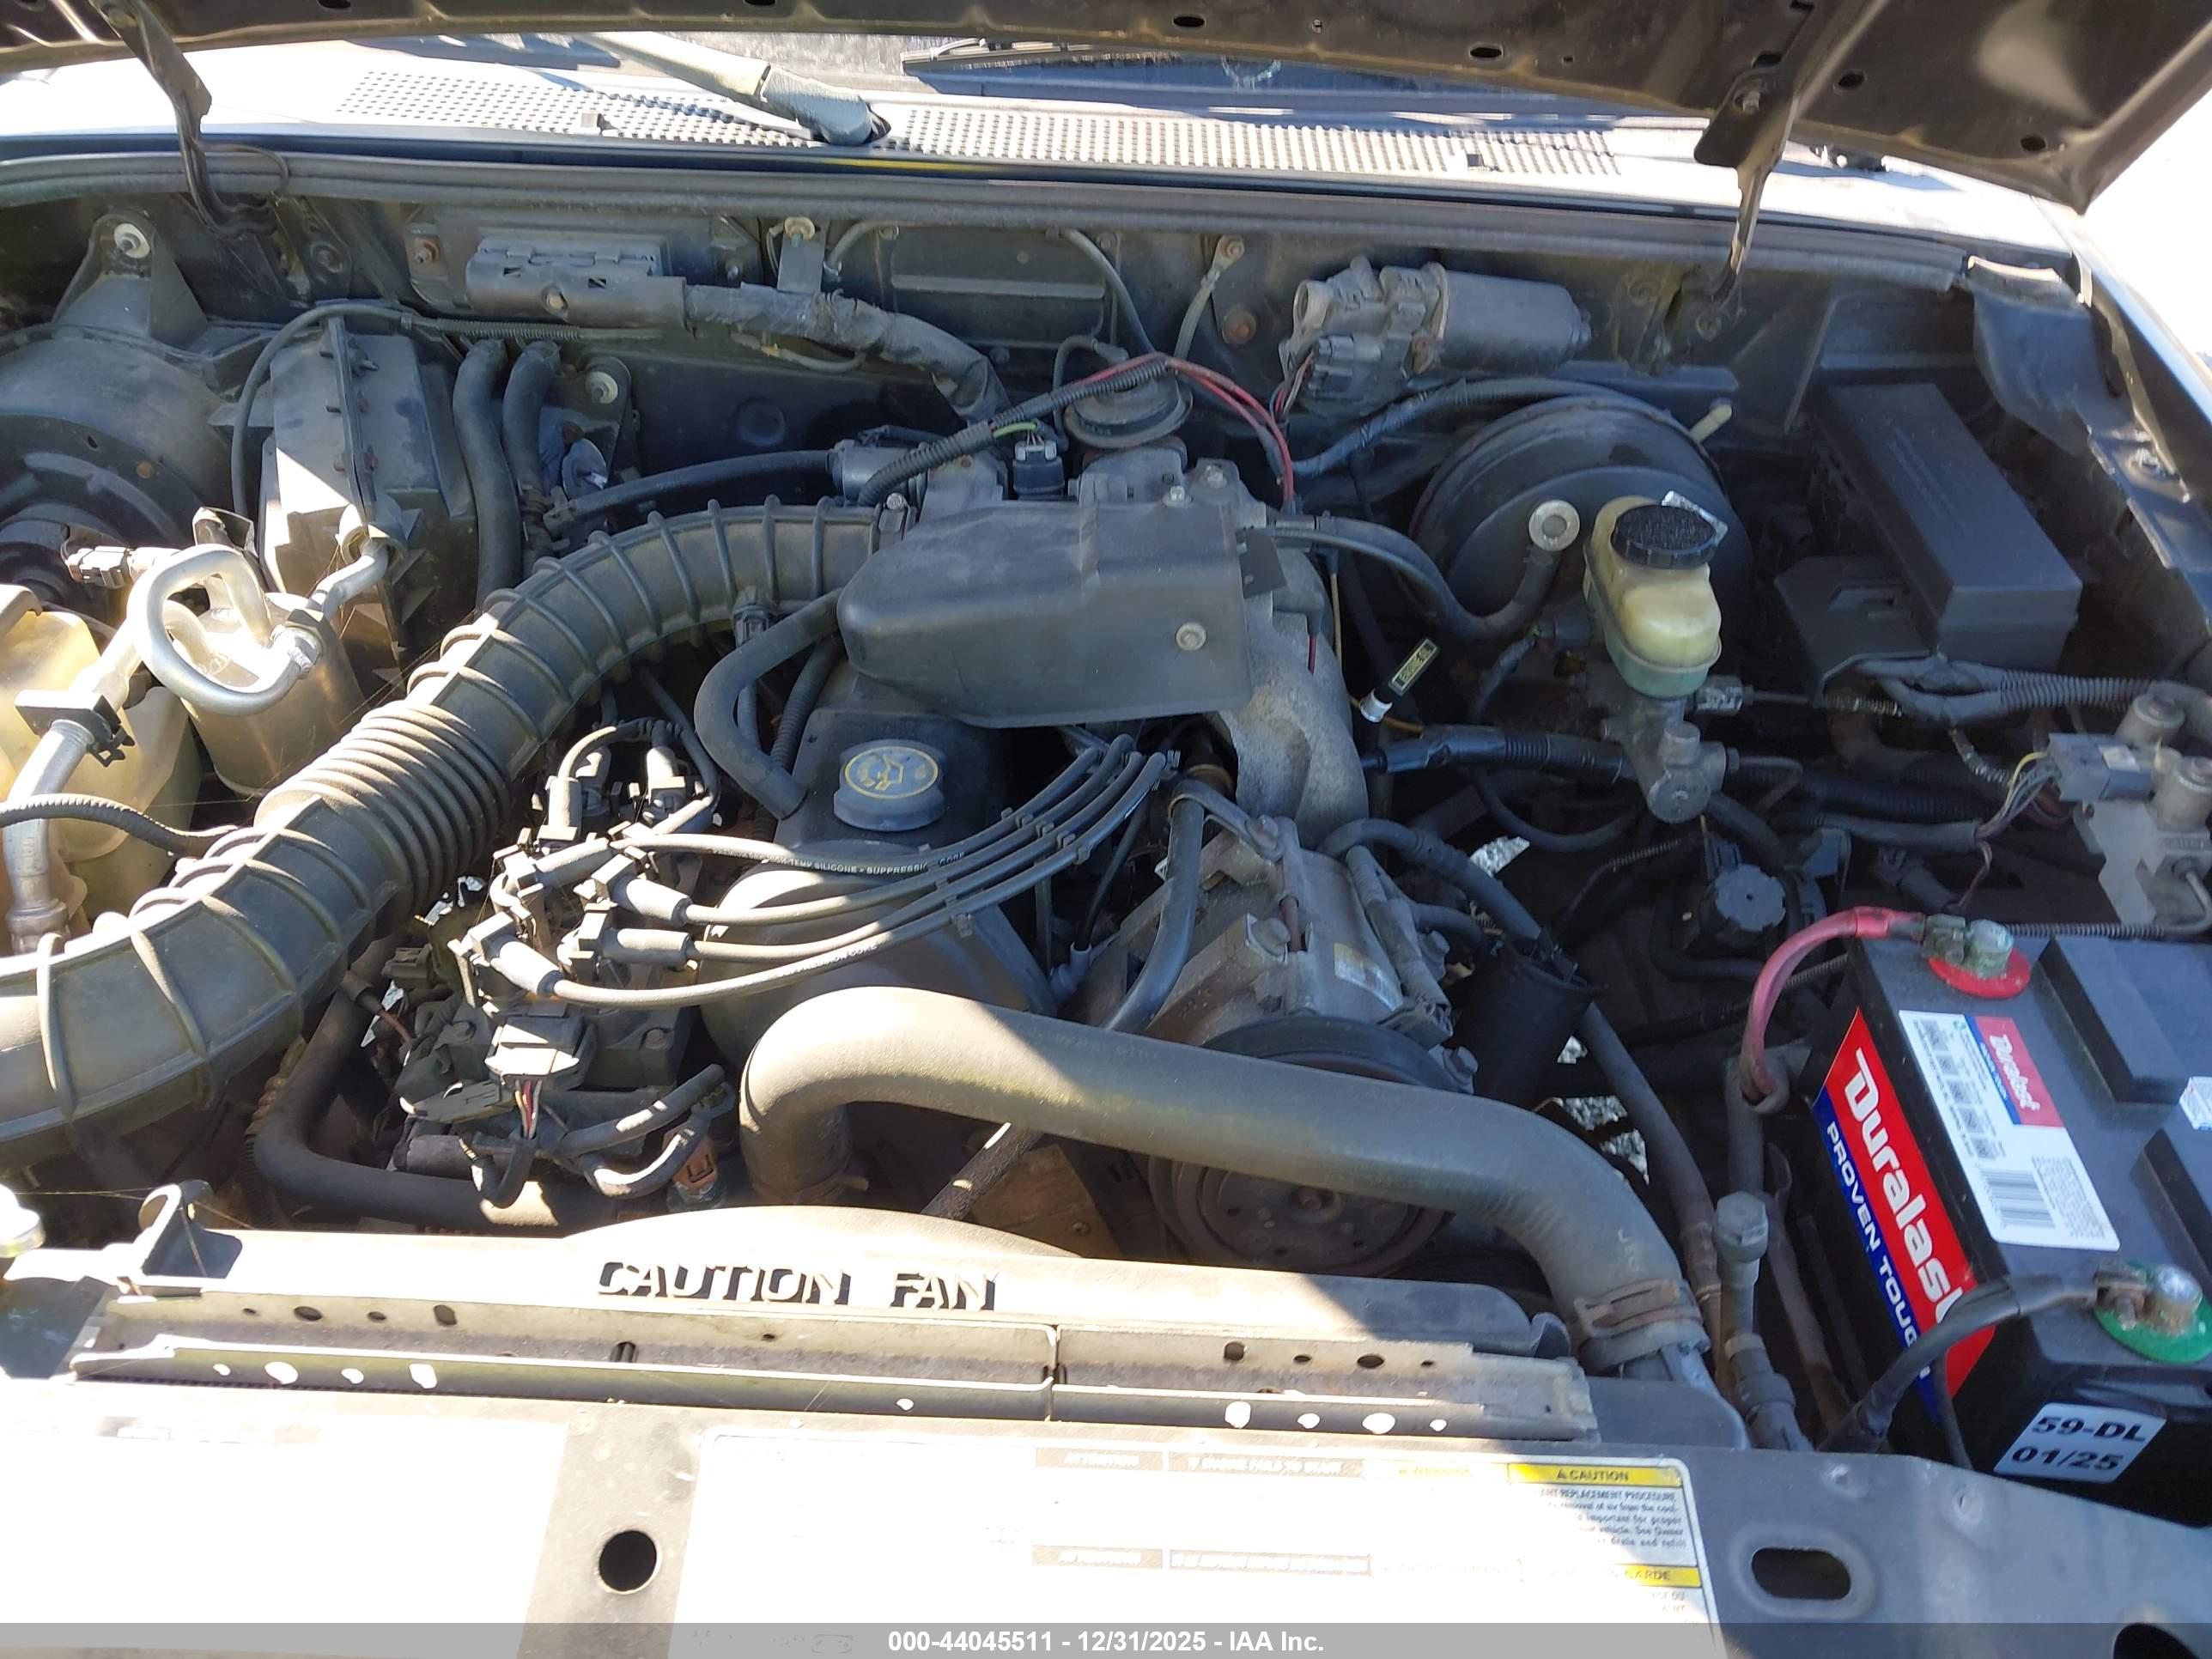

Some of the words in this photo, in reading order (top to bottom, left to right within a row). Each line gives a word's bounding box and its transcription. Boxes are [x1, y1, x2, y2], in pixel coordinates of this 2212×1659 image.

[1826, 1121, 1881, 1252] PROVEN
[598, 1261, 852, 1305] CAUTION
[889, 1272, 996, 1311] FAN
[2032, 1417, 2146, 1443] 59-DL
[2012, 1446, 2124, 1470] 01/25
[1571, 1468, 1629, 1481] CAUTION
